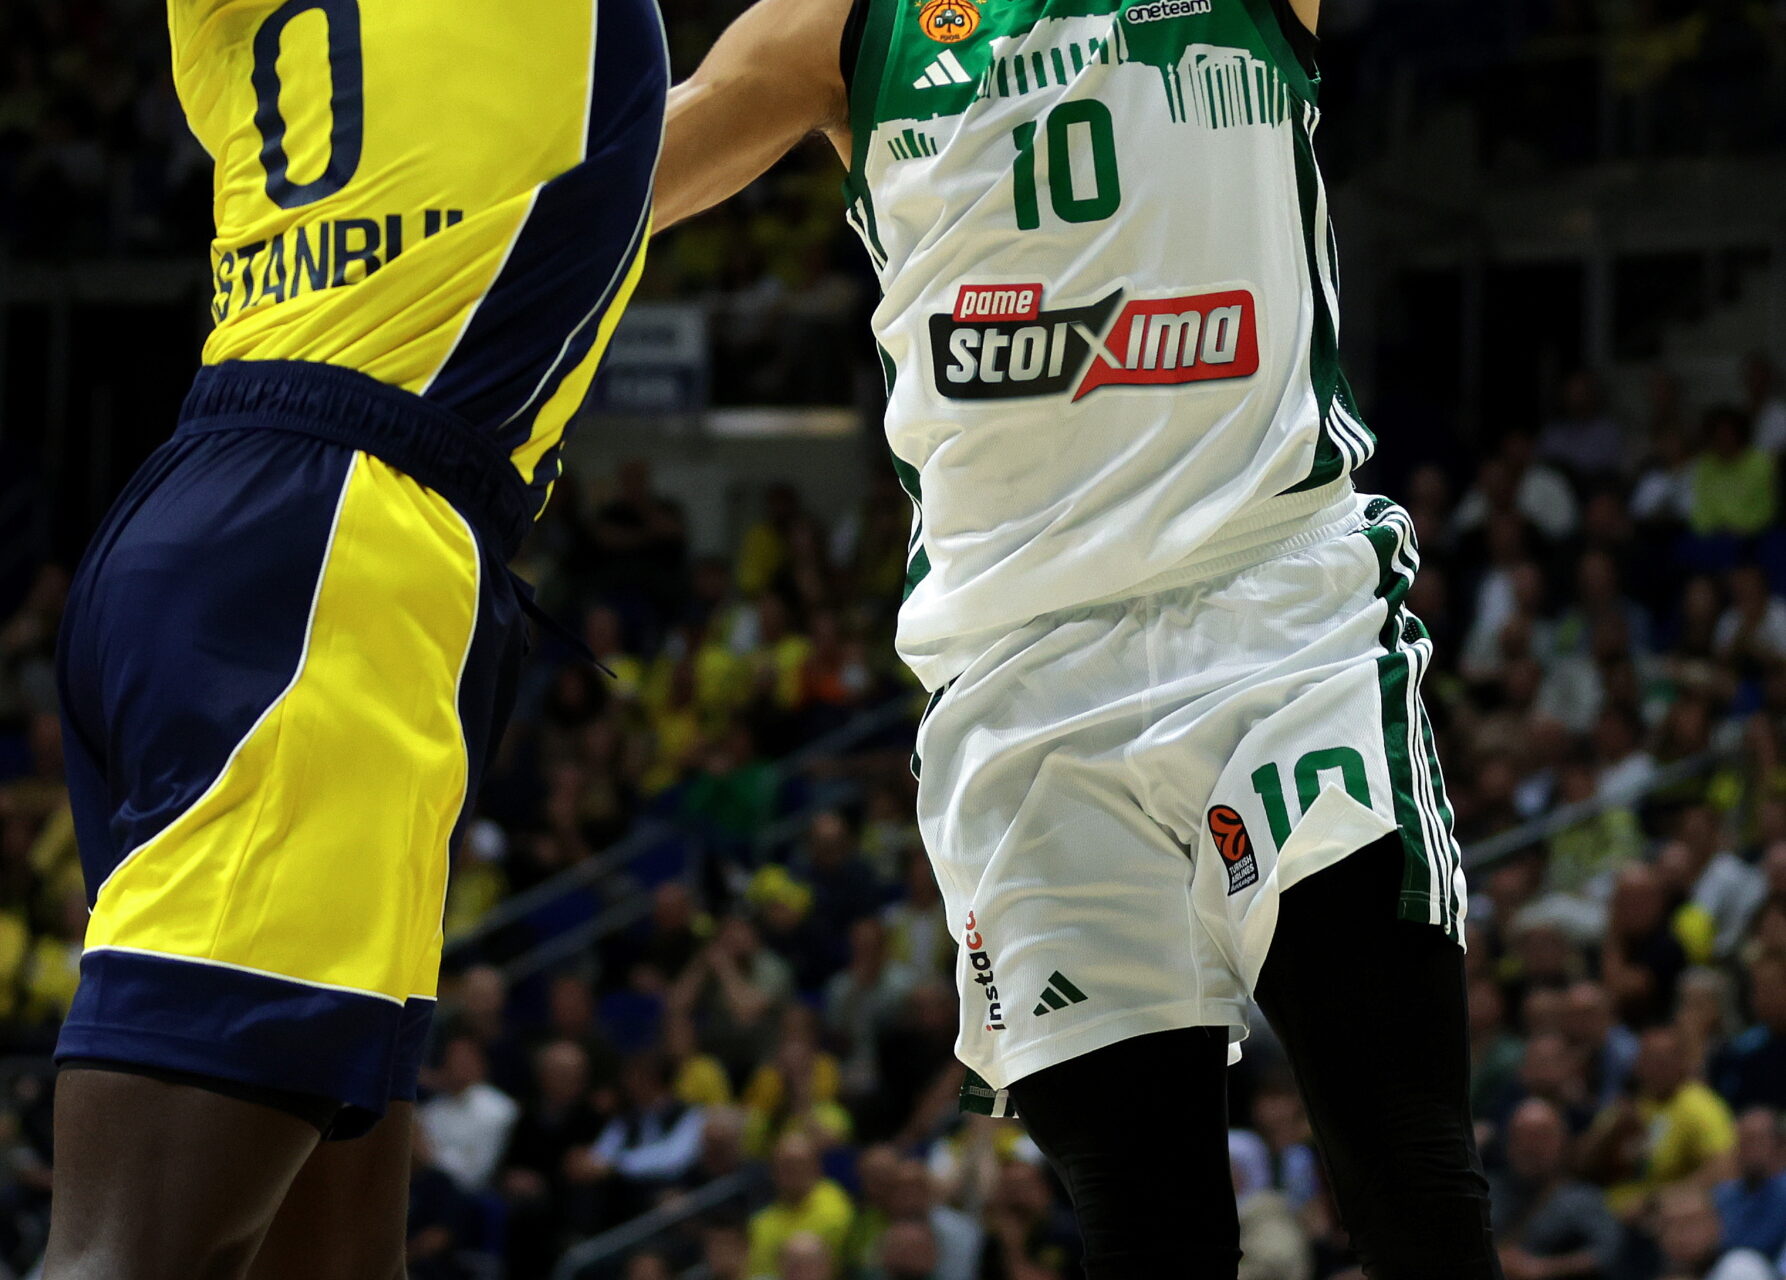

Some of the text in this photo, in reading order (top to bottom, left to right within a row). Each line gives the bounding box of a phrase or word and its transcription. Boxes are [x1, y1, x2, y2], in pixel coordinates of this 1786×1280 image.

[1012, 98, 1121, 231] 10
[211, 208, 464, 325] STANB
[959, 289, 1034, 319] pame
[1250, 745, 1374, 854] 10
[1229, 853, 1253, 875] TURKISH
